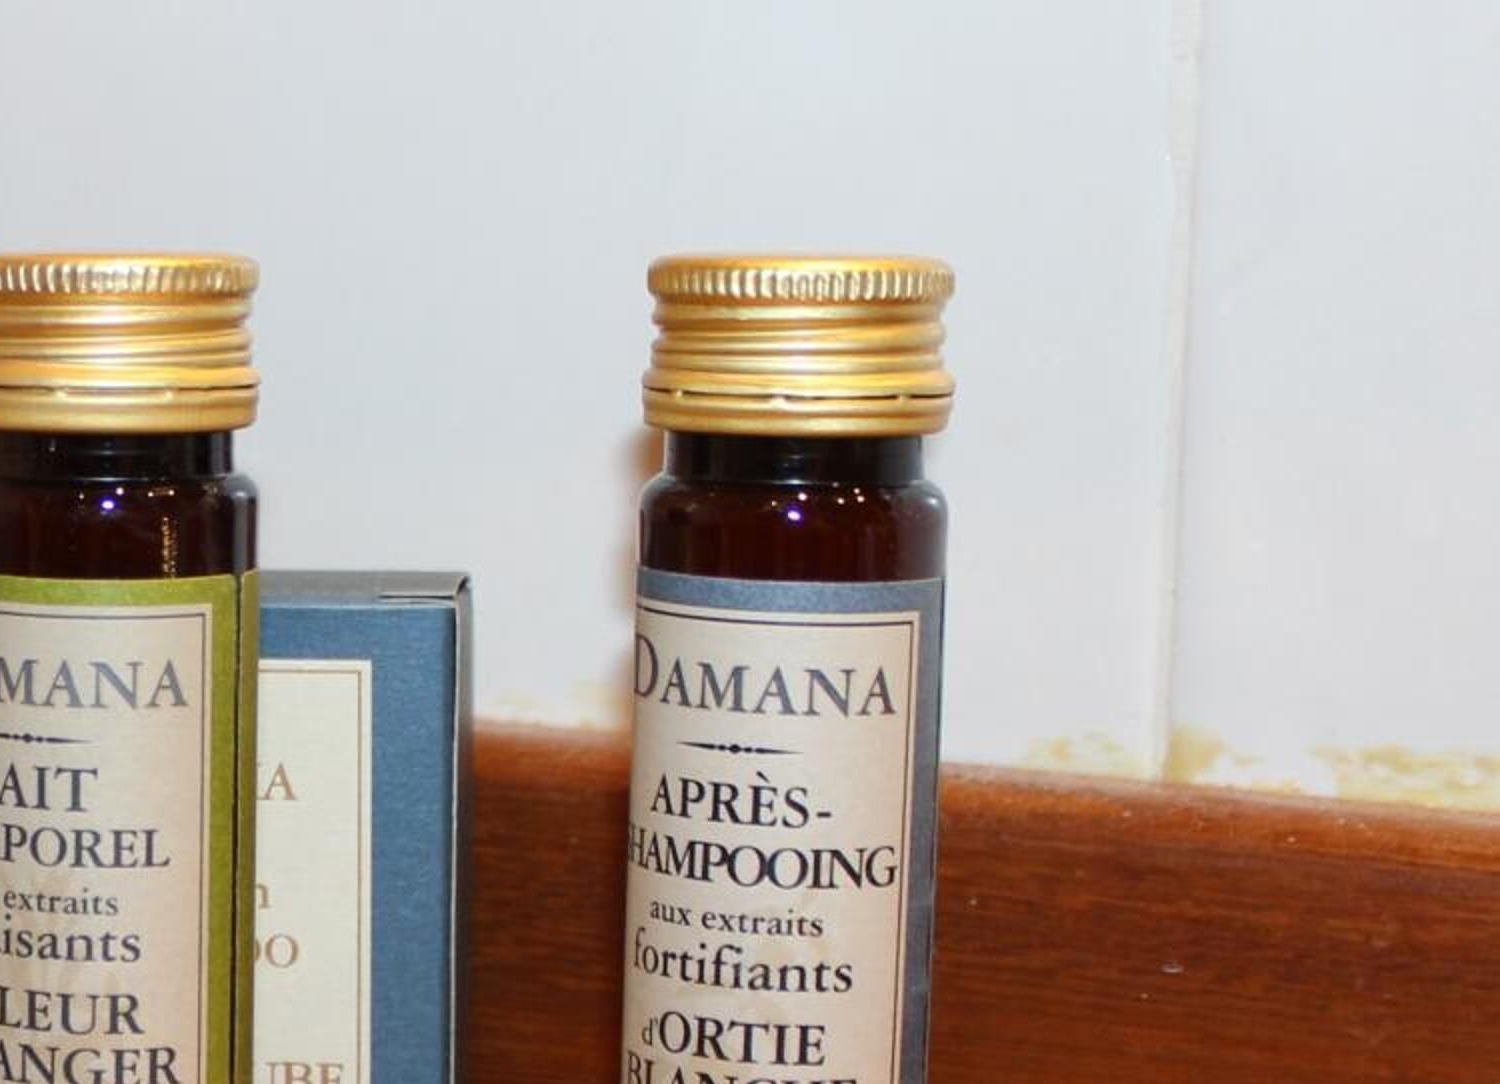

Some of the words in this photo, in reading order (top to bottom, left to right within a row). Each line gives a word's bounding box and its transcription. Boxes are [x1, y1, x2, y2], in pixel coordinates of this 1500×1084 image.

[633, 632, 898, 718] DAMANA
[649, 770, 832, 829] APRÈS-
[628, 822, 898, 889] HAMPOOING
[3, 887, 119, 917] extraits
[650, 900, 692, 927] aux
[701, 909, 824, 938] extraits
[634, 927, 854, 993] fortifiants
[641, 1011, 826, 1066] d'ORTIE
